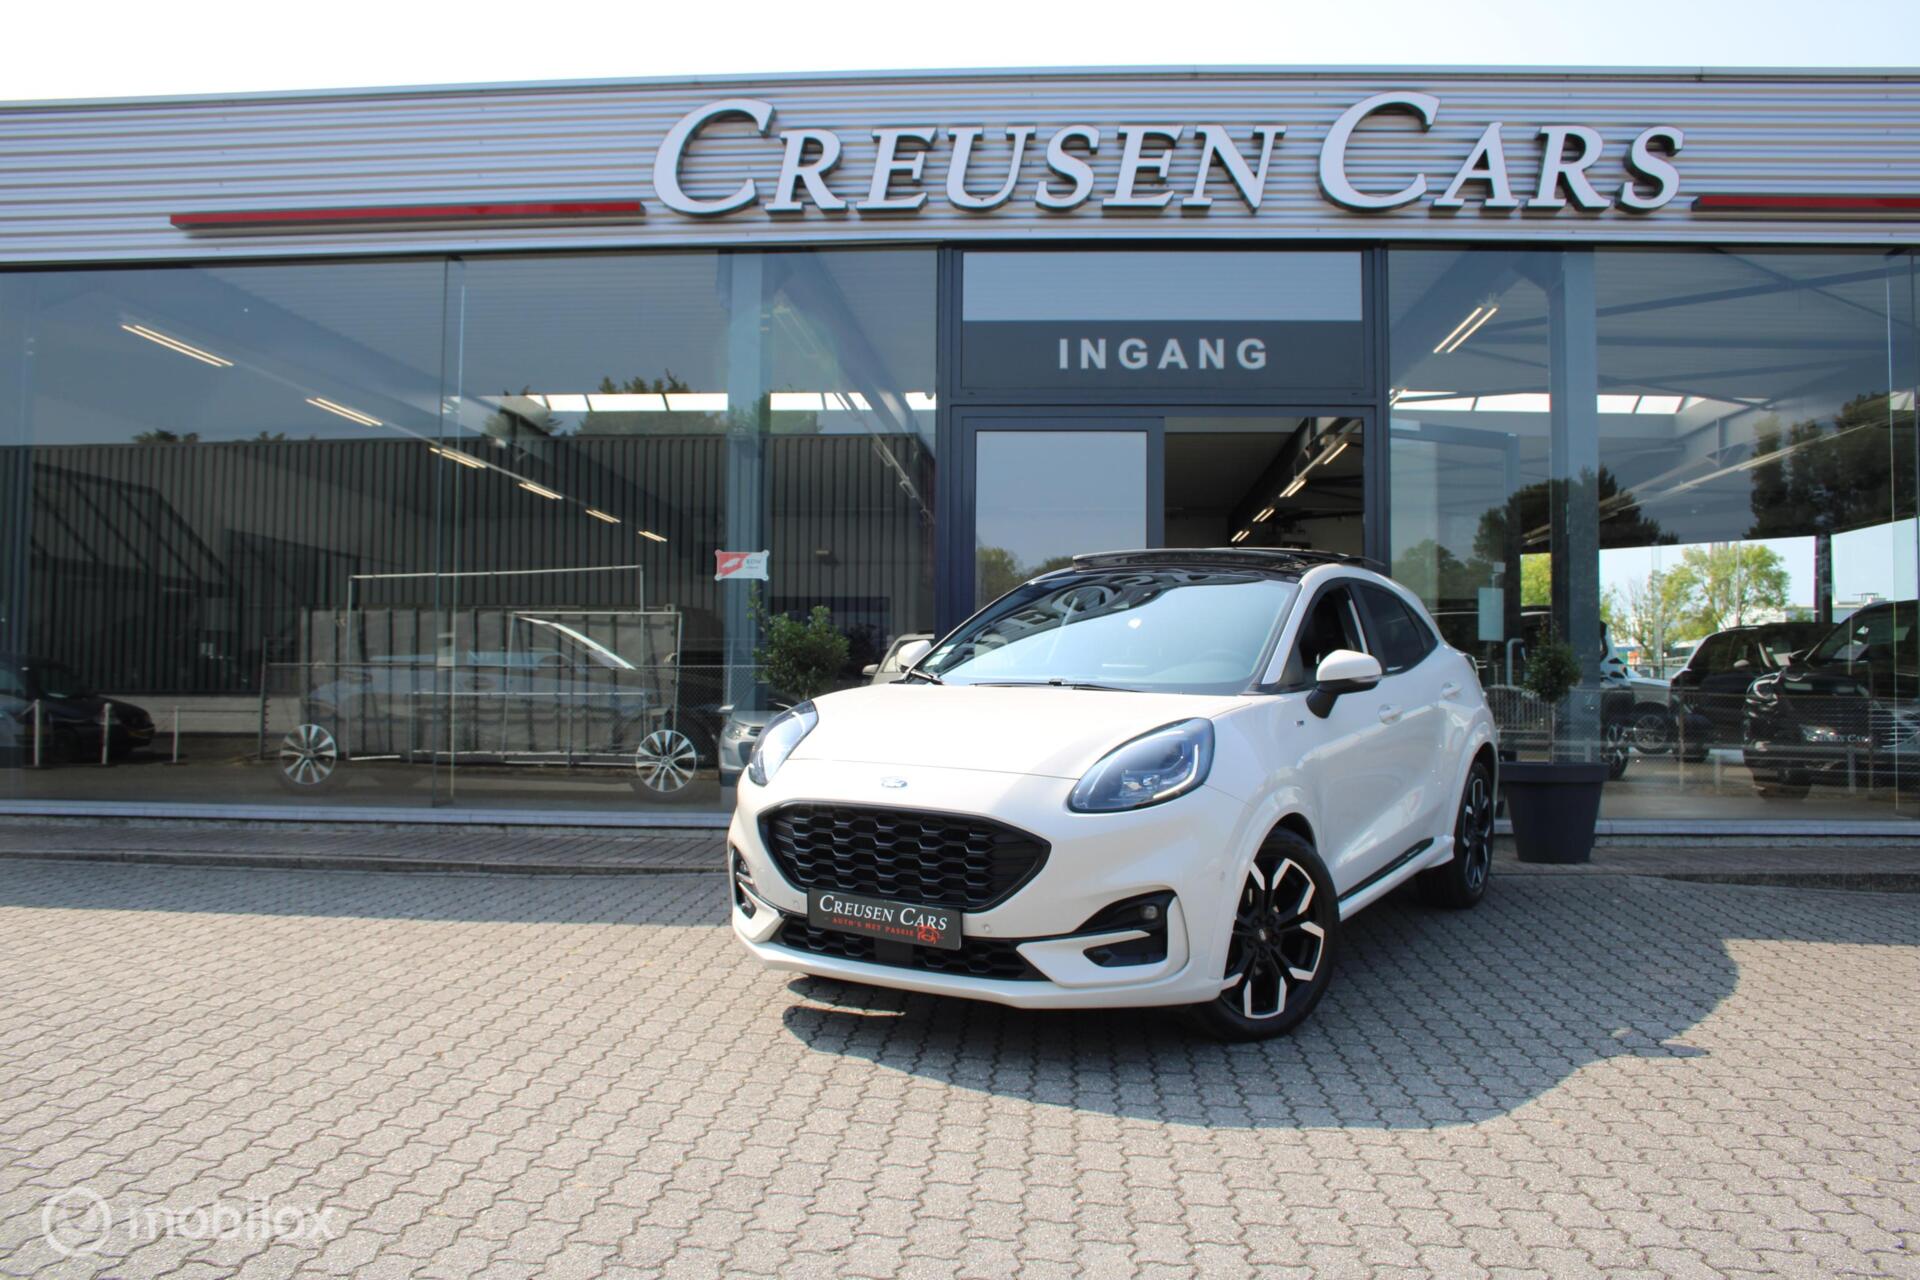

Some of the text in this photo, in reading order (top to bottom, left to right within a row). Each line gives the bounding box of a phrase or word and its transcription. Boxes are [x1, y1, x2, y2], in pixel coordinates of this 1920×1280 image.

[652, 90, 1685, 214] CREUSEN CARS
[1058, 337, 1267, 370] INGANG
[819, 894, 948, 931] CREUSEN CARS
